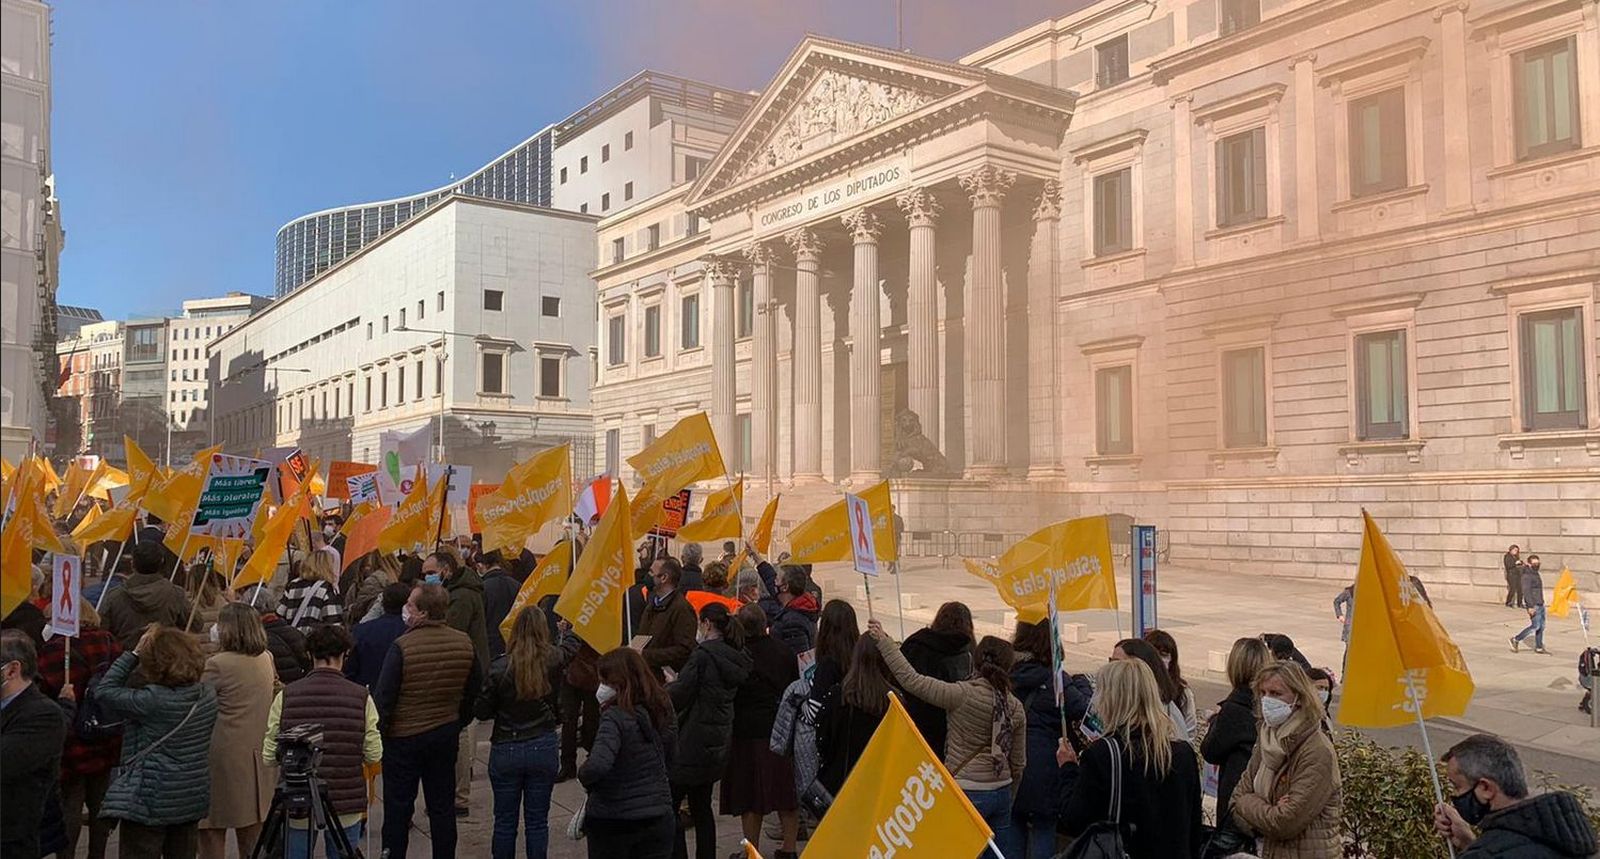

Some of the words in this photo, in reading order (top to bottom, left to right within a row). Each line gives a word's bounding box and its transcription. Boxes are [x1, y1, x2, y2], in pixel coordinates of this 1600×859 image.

[761, 203, 803, 226] CONGRESO
[808, 198, 819, 211] DE
[824, 188, 841, 205] LOS
[846, 167, 900, 197] DIPUTADOS
[214, 479, 231, 487] Más
[234, 478, 257, 486] libres
[202, 494, 221, 502] Más
[223, 492, 260, 502] plurales
